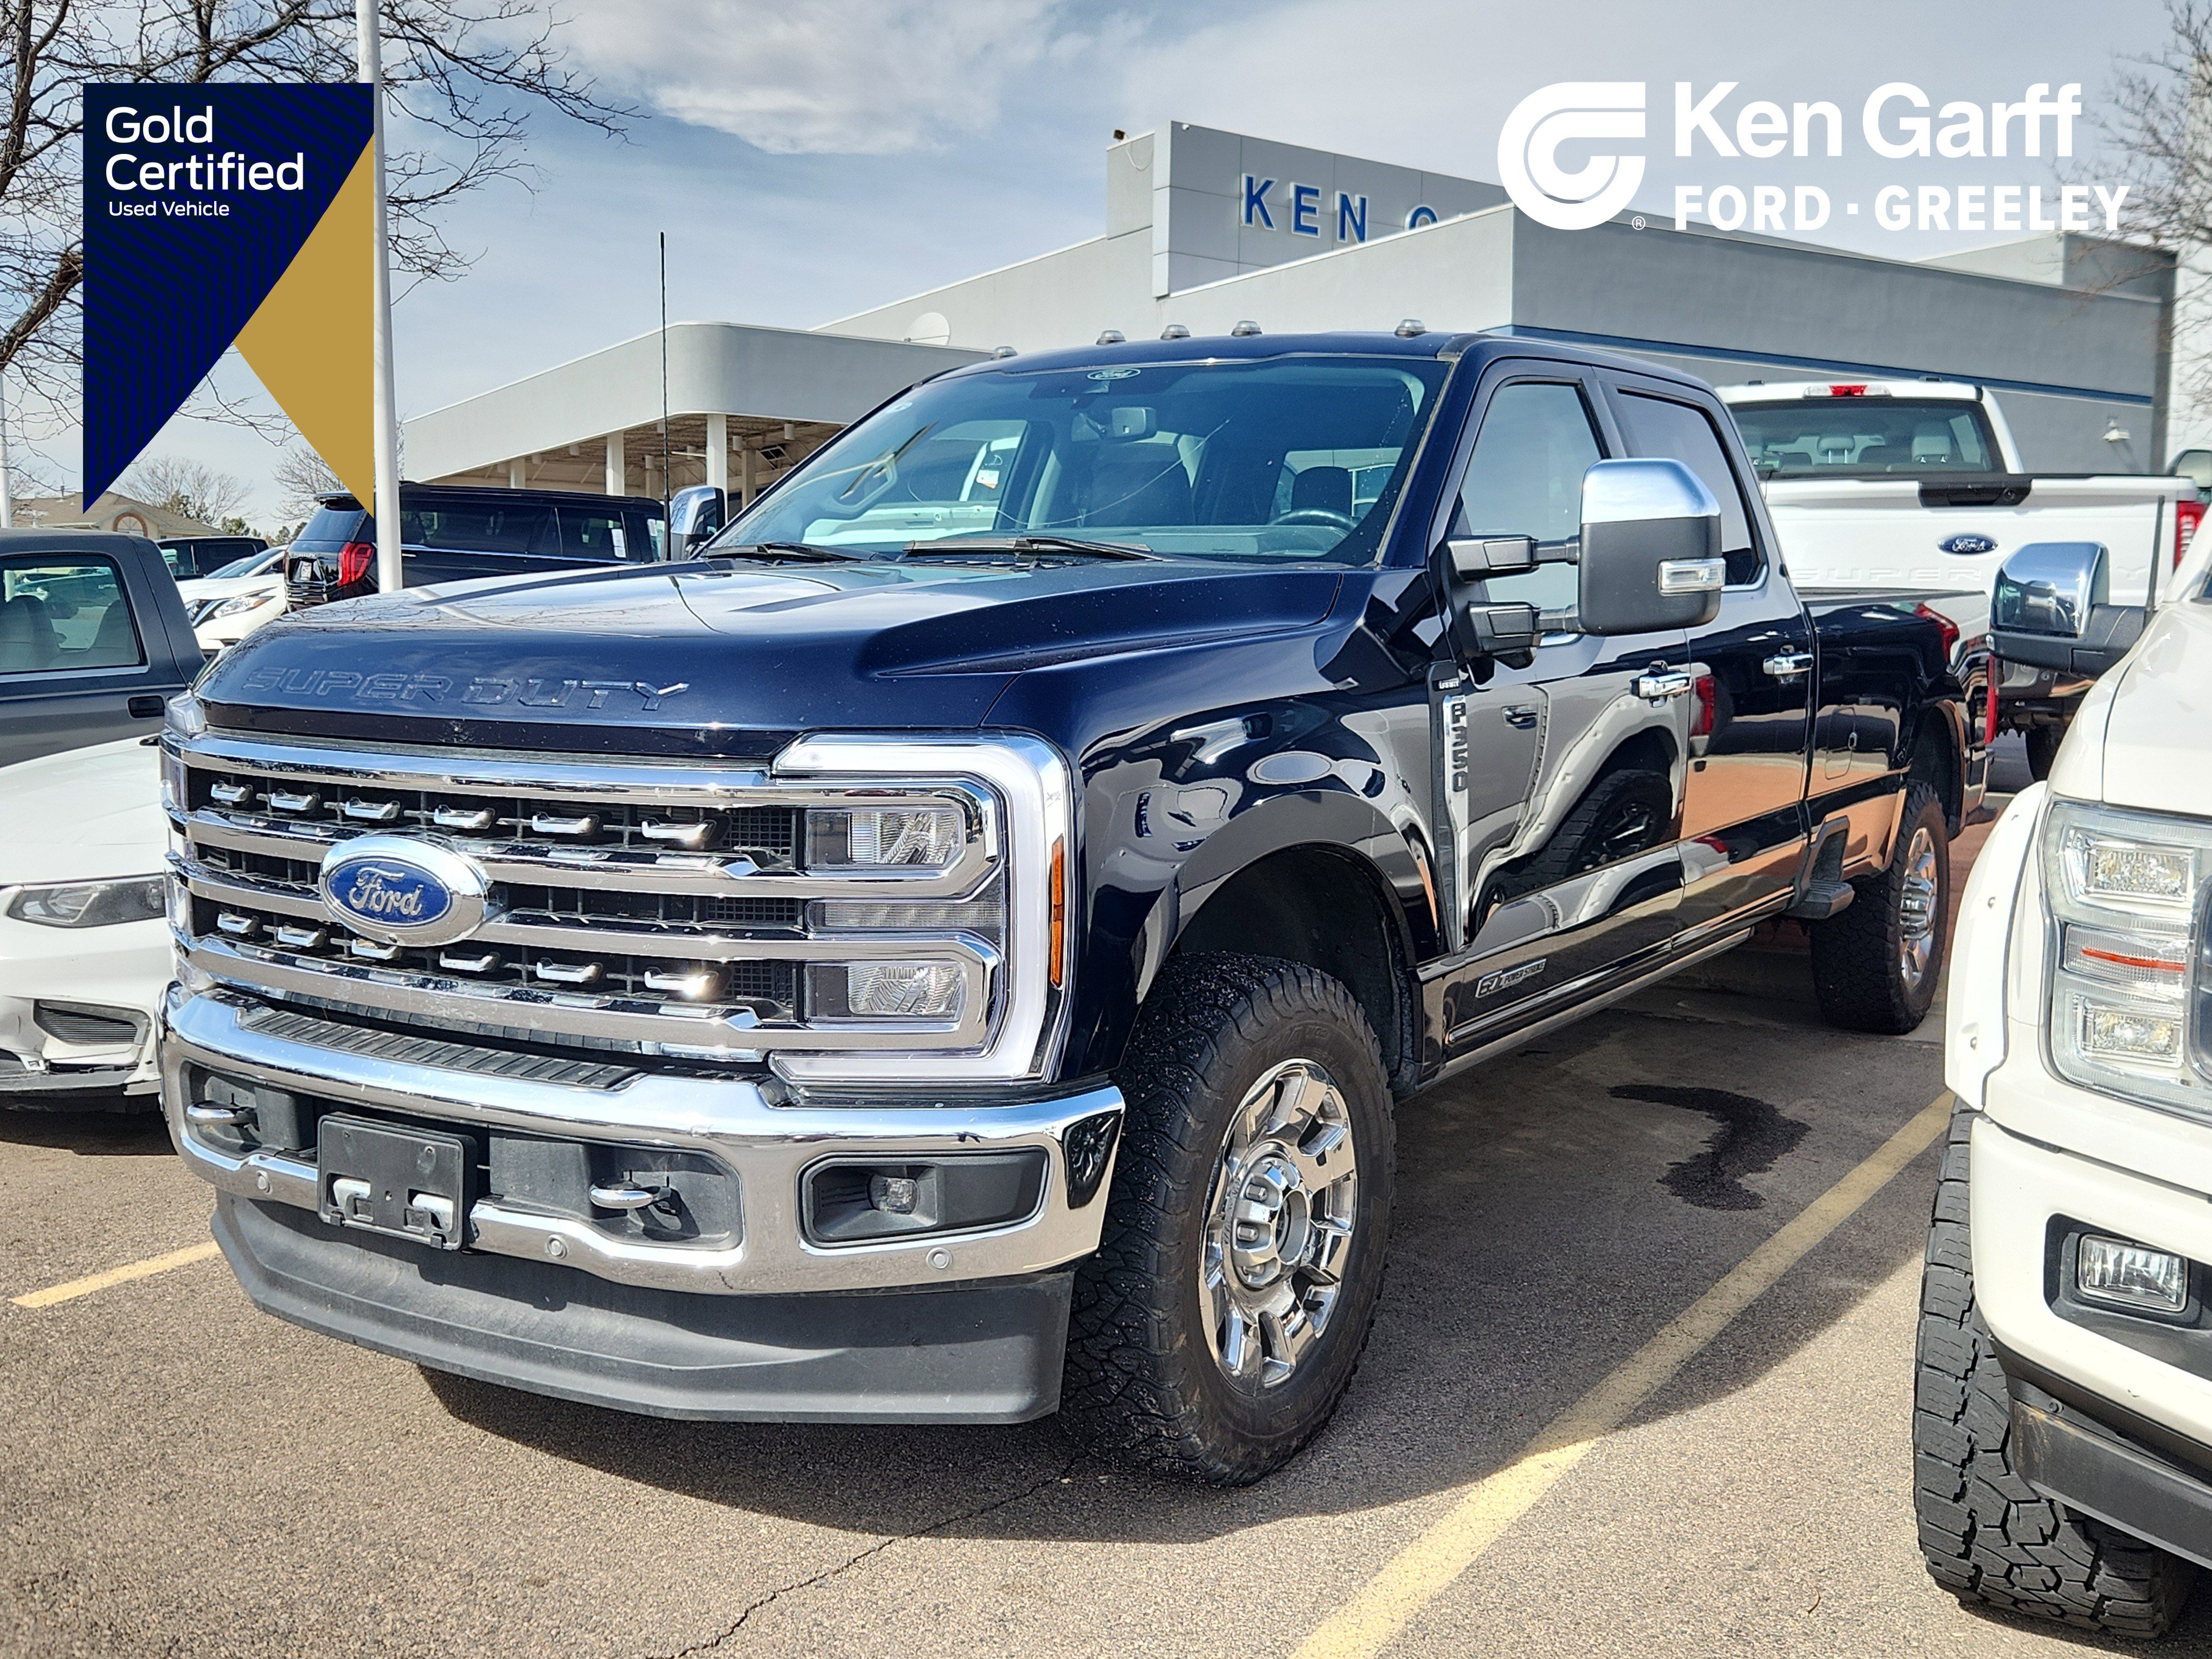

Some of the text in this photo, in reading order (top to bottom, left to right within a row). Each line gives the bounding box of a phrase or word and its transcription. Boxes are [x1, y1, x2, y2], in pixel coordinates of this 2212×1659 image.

[1240, 172, 1368, 243] KEN
[1790, 567, 1982, 582] SUPER
[242, 667, 690, 711] SUPER DUTY
[349, 867, 425, 916] Ford
